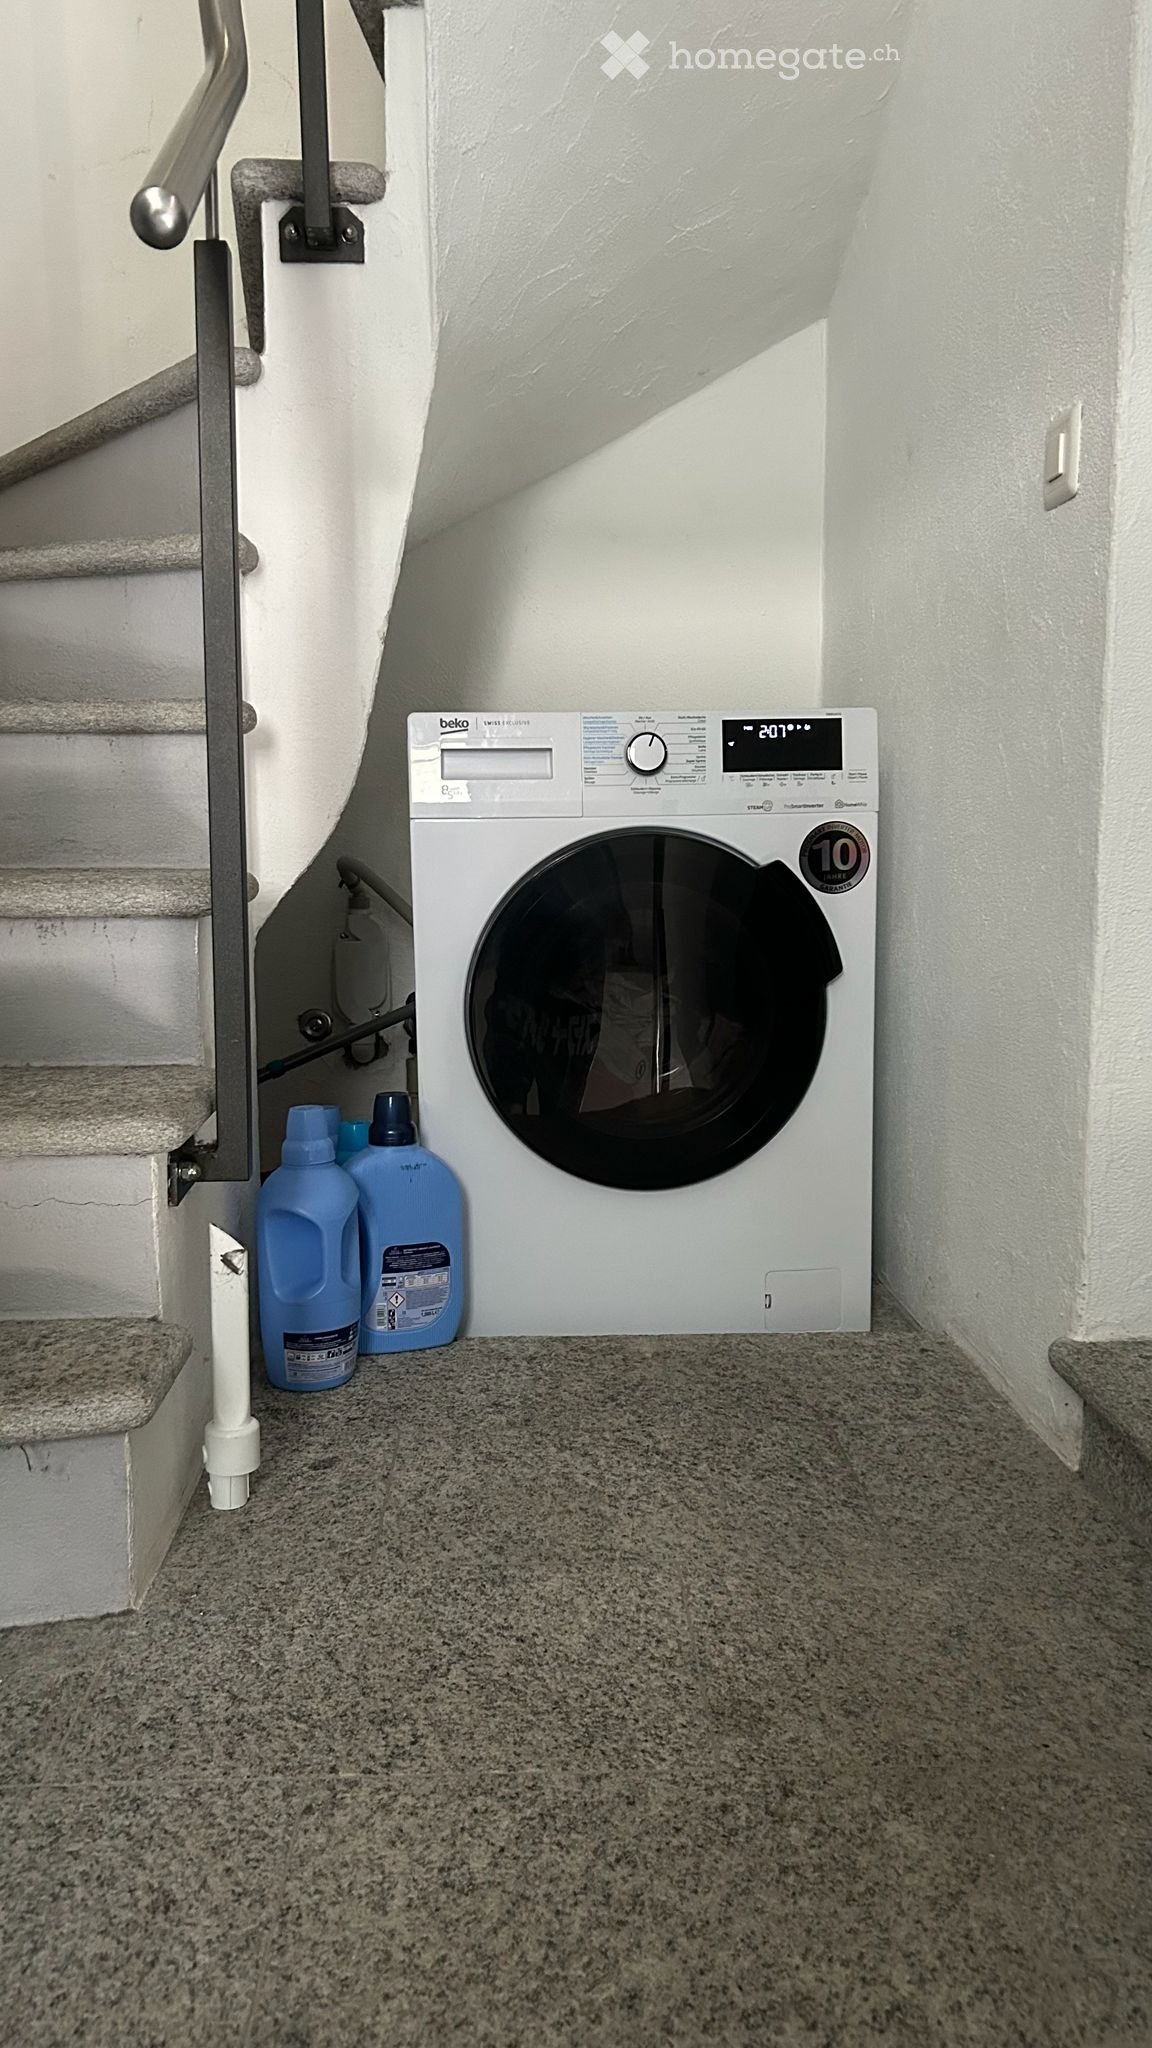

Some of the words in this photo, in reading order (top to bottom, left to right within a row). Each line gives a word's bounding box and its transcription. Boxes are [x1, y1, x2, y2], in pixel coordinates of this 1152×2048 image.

[440, 718, 469, 729] beko
[812, 837, 857, 872] 10
[823, 872, 847, 881] JAHRE
